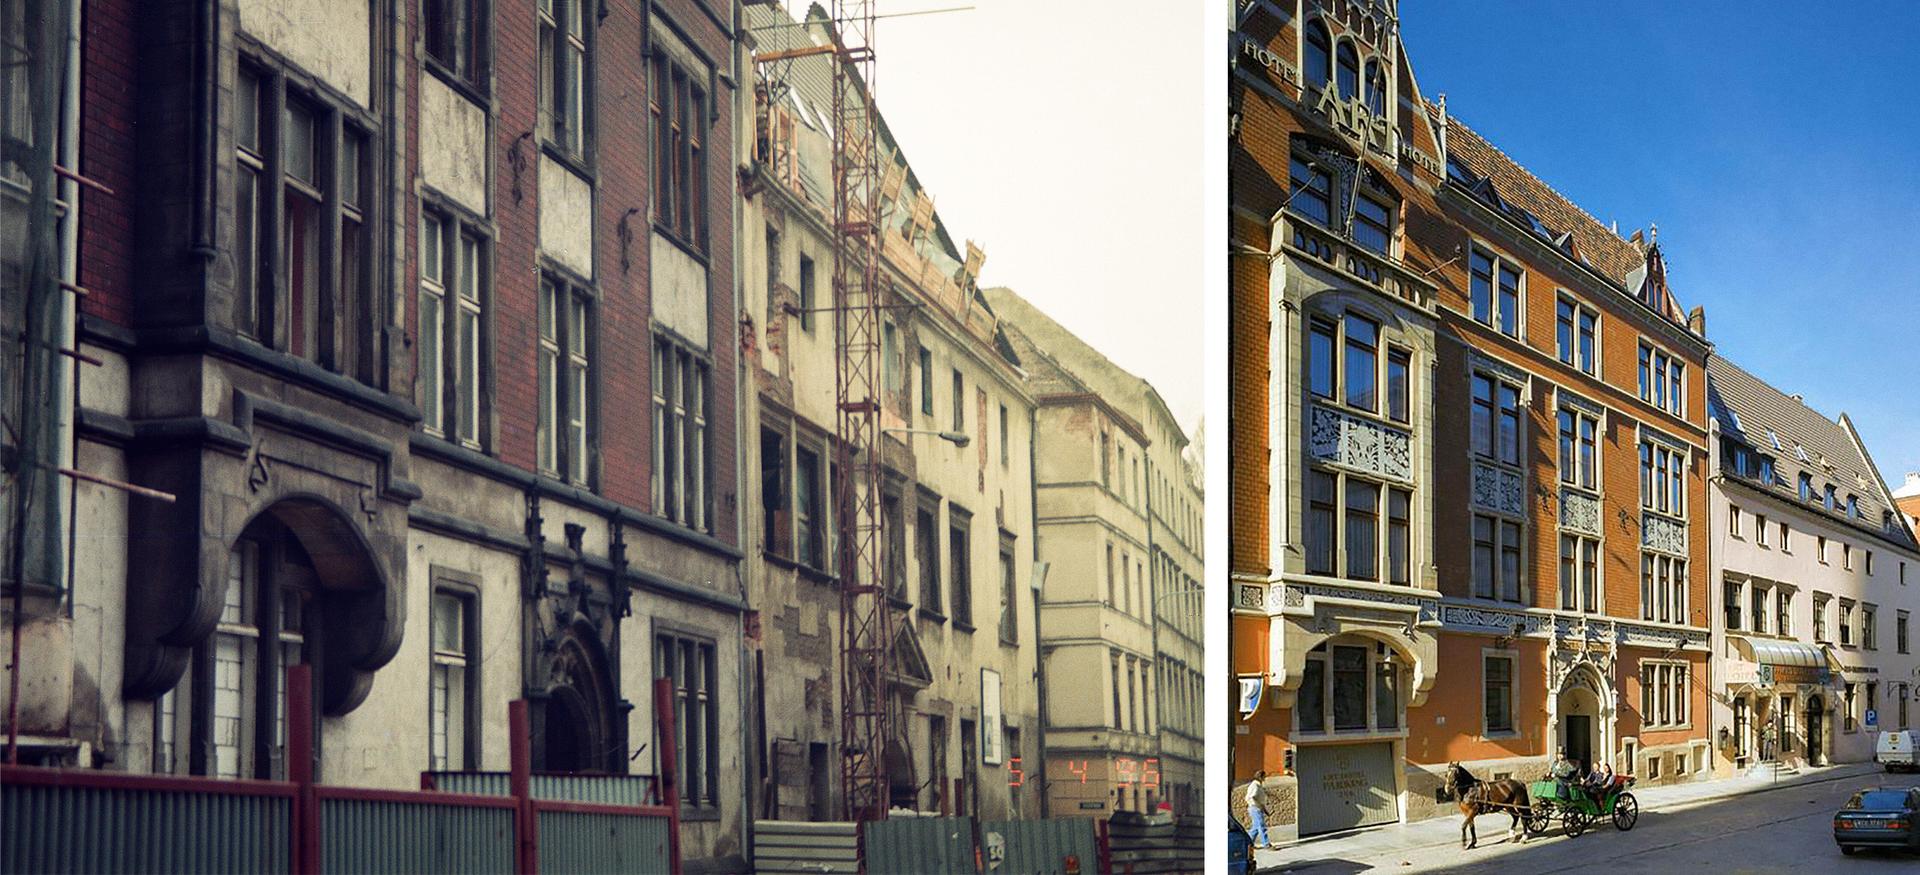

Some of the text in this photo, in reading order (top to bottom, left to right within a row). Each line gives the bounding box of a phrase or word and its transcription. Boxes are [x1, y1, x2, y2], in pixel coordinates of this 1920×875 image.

[1244, 39, 1299, 84] HOTE
[1313, 80, 1403, 157] ART
[1867, 710, 1875, 722] P
